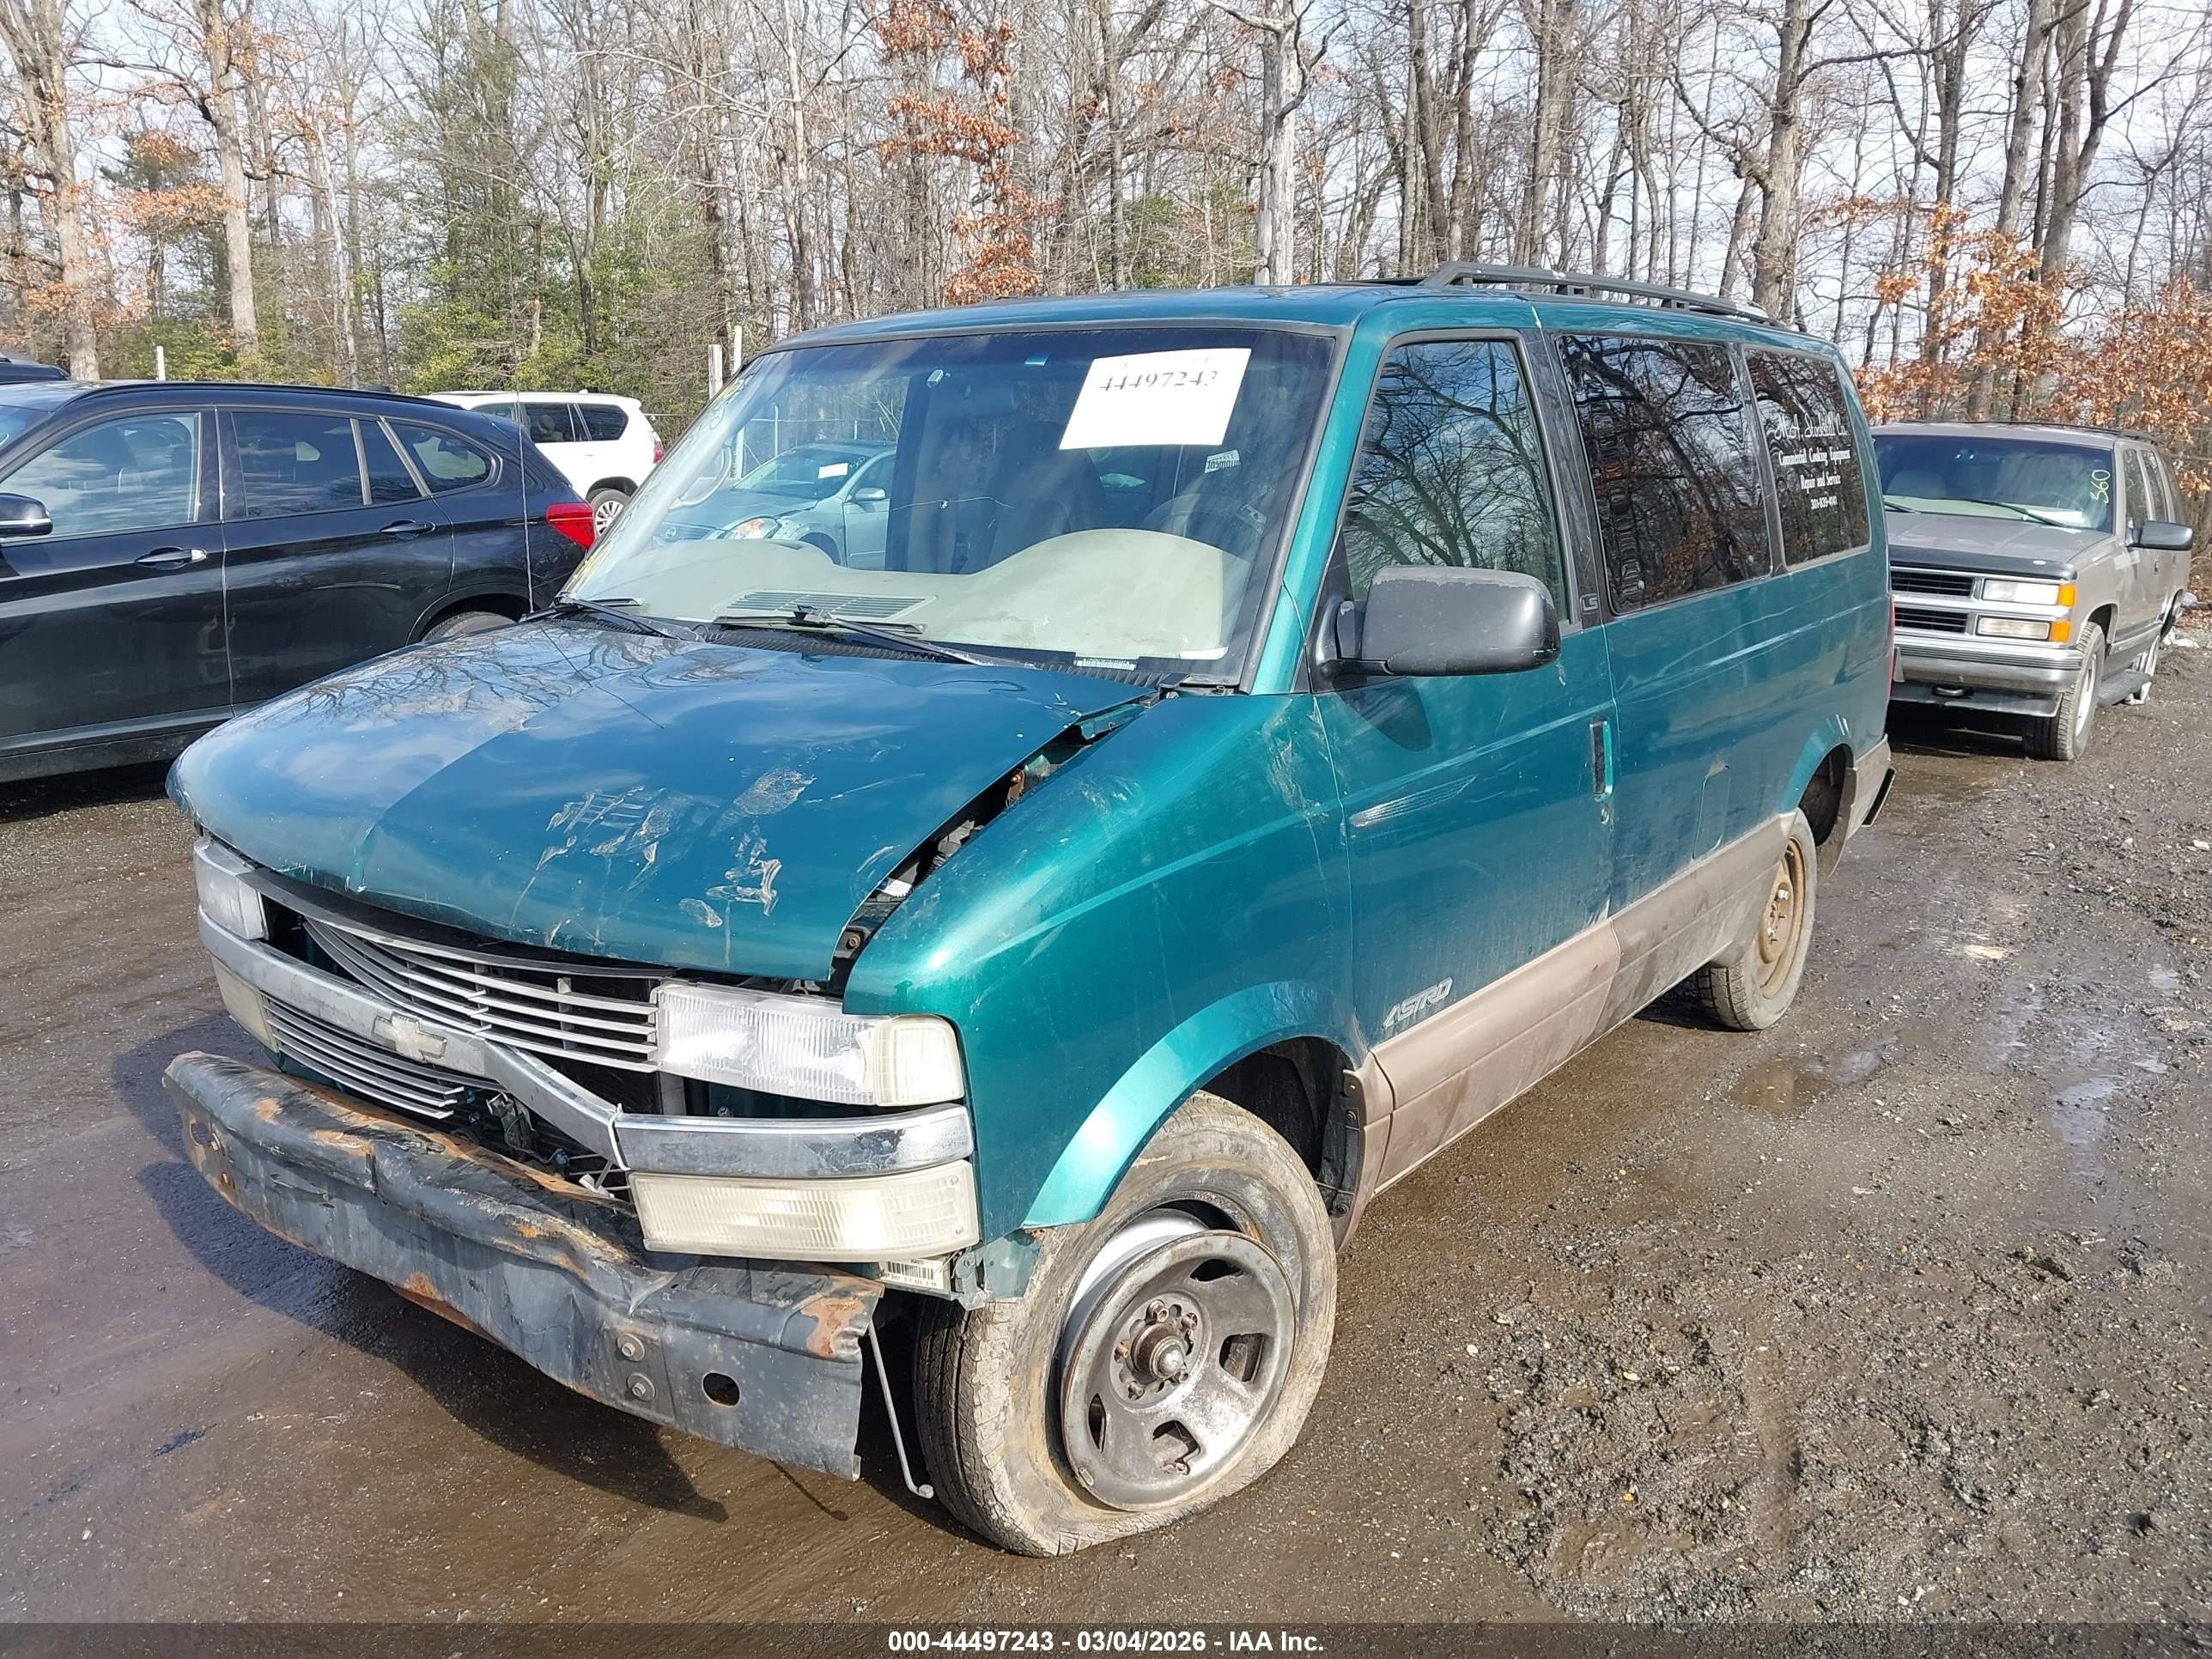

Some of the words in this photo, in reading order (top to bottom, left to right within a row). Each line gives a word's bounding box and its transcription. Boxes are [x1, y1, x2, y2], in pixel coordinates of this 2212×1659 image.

[1778, 448, 1808, 466] Commercial
[1808, 447, 1829, 466] Cooking
[1829, 447, 1851, 465] Equipment
[1800, 474, 1815, 495] Repair
[1816, 471, 1826, 488] and
[1826, 471, 1841, 487] Service
[2089, 470, 2111, 503] 360
[1582, 596, 1599, 612] LS
[1382, 977, 1453, 1030] ASTRO
